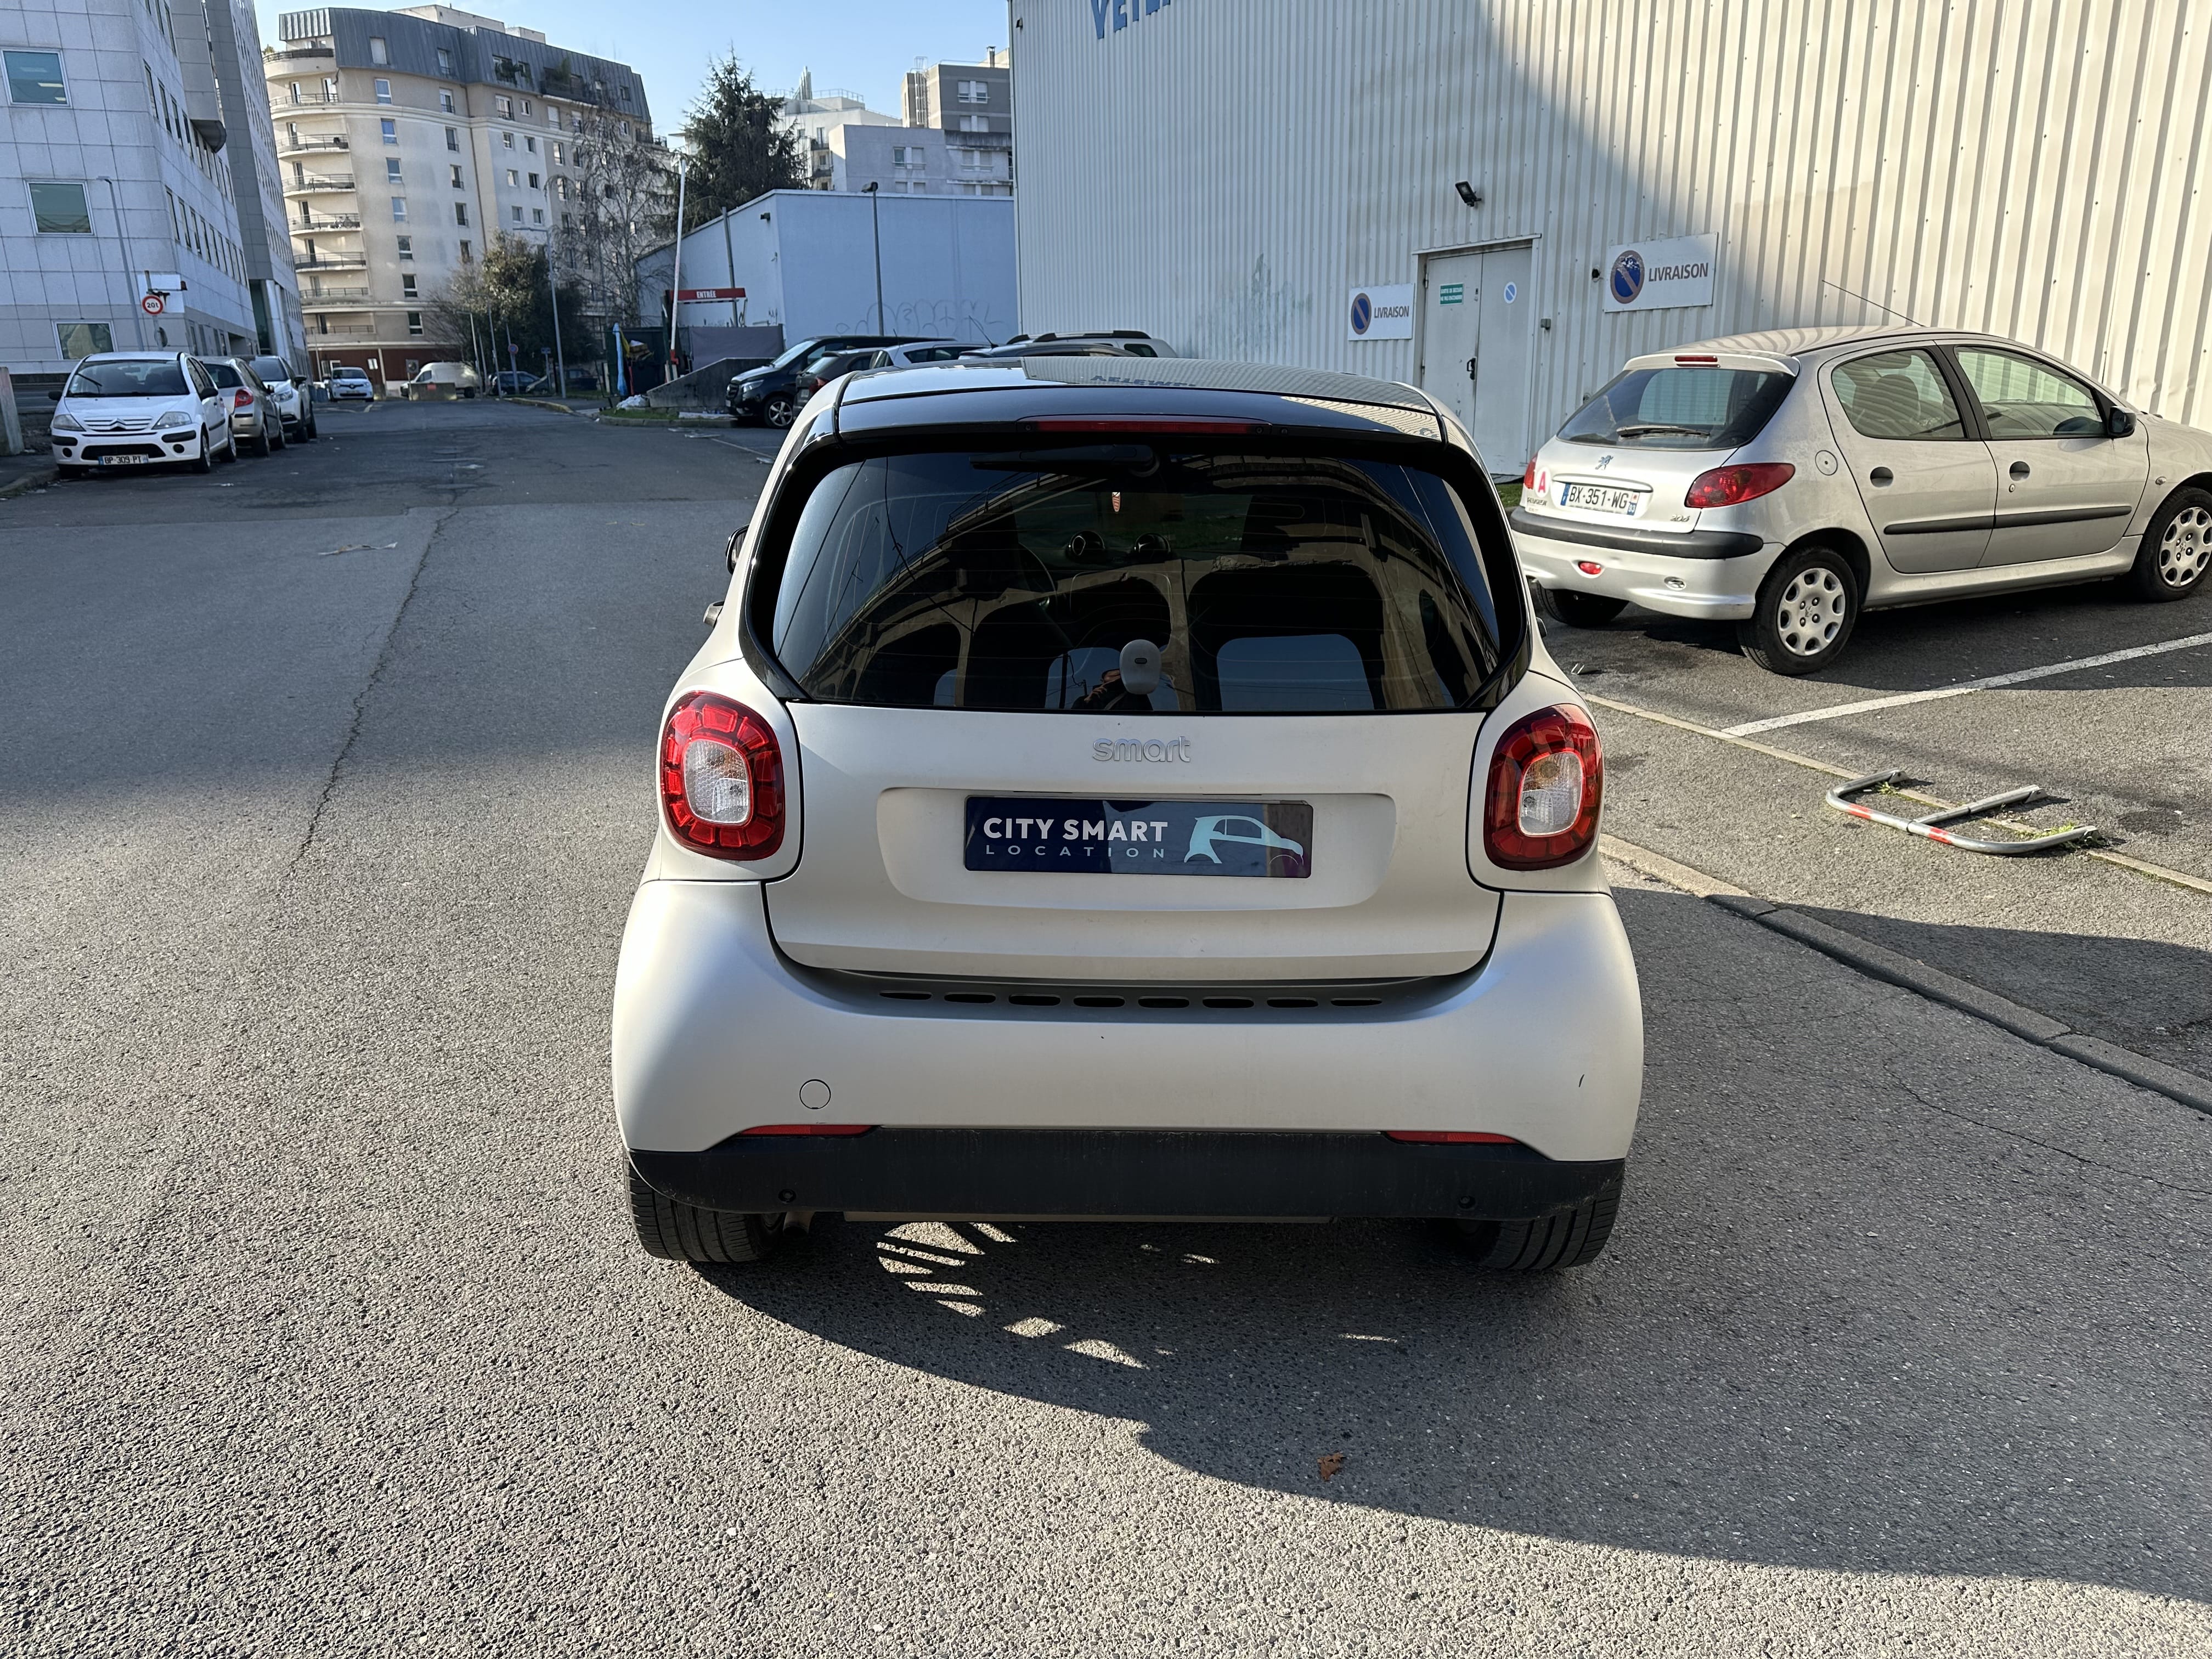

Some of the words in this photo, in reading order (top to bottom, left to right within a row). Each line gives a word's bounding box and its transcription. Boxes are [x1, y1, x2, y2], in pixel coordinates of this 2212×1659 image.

[1649, 262, 1709, 282] LIVRAISON
[696, 290, 716, 299] ENTRÉE
[1374, 306, 1409, 318] LIVRAISON
[1538, 471, 1546, 493] A
[1092, 736, 1190, 762] smart
[984, 817, 1054, 839] CITY
[1063, 819, 1168, 842] SMART
[986, 845, 1164, 859] LOCATION
